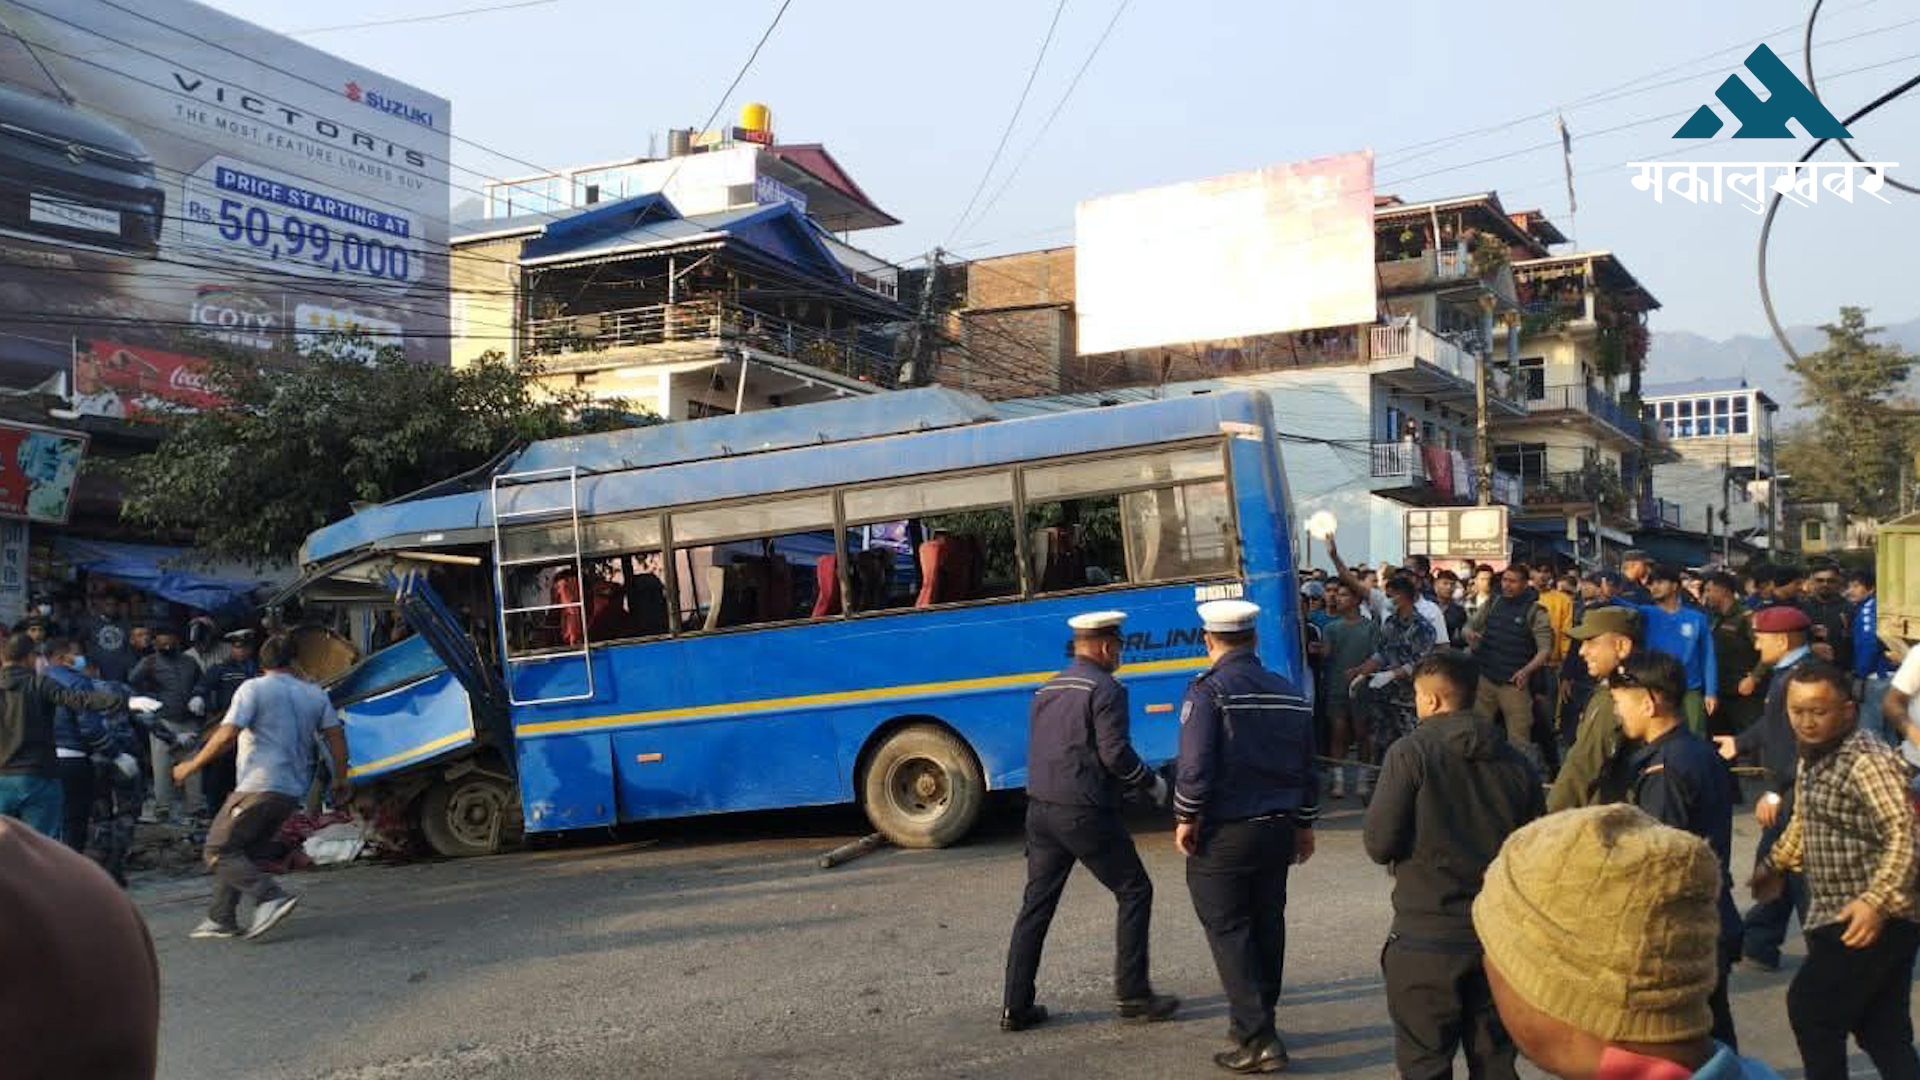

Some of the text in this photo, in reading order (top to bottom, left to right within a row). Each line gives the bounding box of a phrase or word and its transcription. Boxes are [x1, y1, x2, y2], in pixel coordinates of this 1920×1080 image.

[172, 72, 425, 168] VICTORIS
[175, 103, 207, 124] THE
[215, 116, 258, 138] MOST
[267, 132, 333, 162] FEATURE
[340, 154, 393, 181] LOADED
[366, 90, 433, 127] SUZUKI
[218, 199, 409, 281] 50,99,000
[223, 170, 409, 233] PRICE STARTING AT
